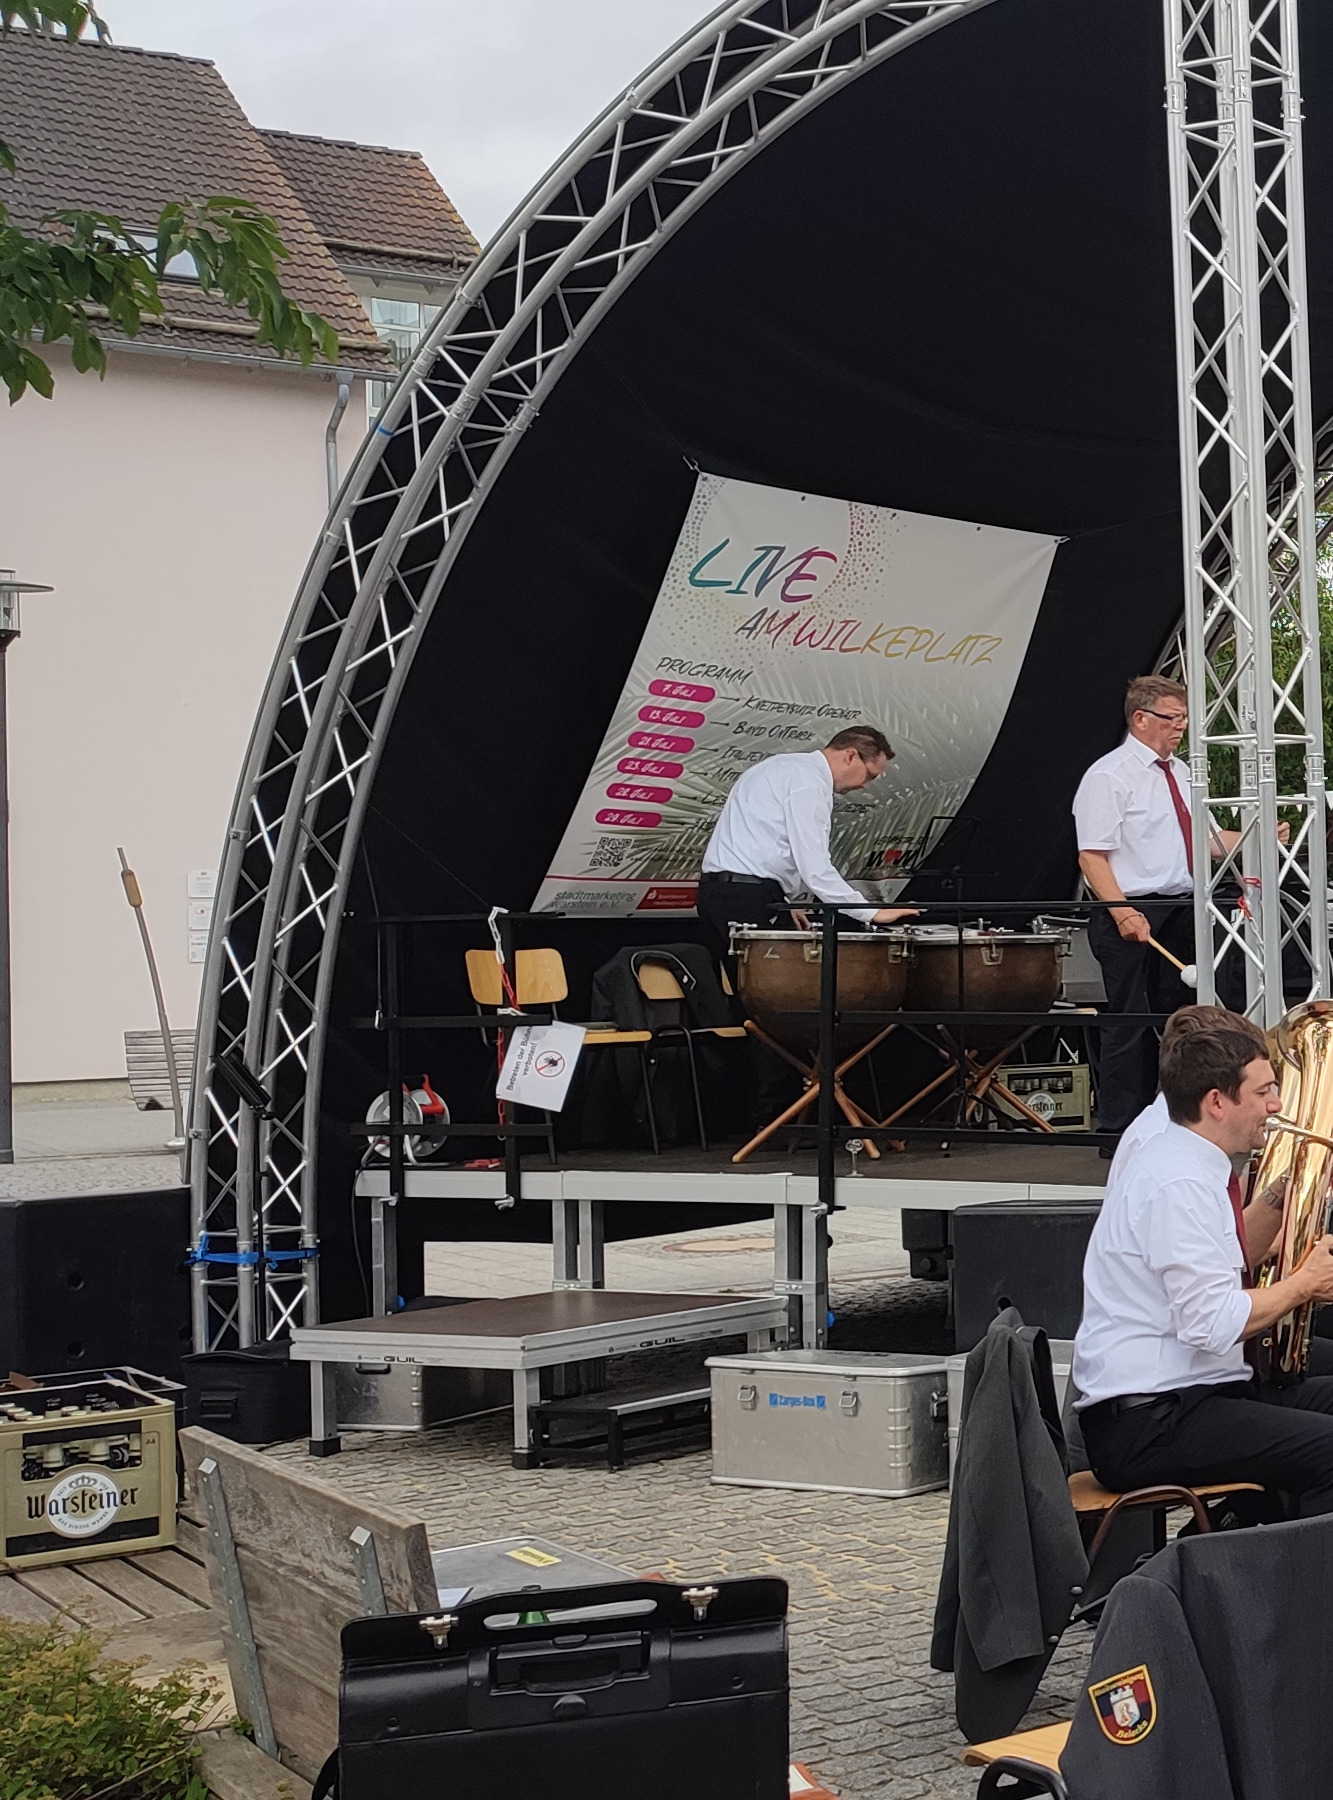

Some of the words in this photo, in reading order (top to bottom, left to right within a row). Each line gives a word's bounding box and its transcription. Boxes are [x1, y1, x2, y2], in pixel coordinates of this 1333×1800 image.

[688, 538, 838, 603] LIVE
[735, 607, 800, 649] AM
[793, 615, 1002, 666] WILKEPLATZ
[656, 657, 754, 685] PROGRAMM
[732, 721, 766, 737] BAND
[520, 1026, 533, 1047] Bühn
[639, 1336, 685, 1348] GUIL
[383, 1355, 424, 1364] GUIL
[27, 1487, 139, 1519] Warsteiner
